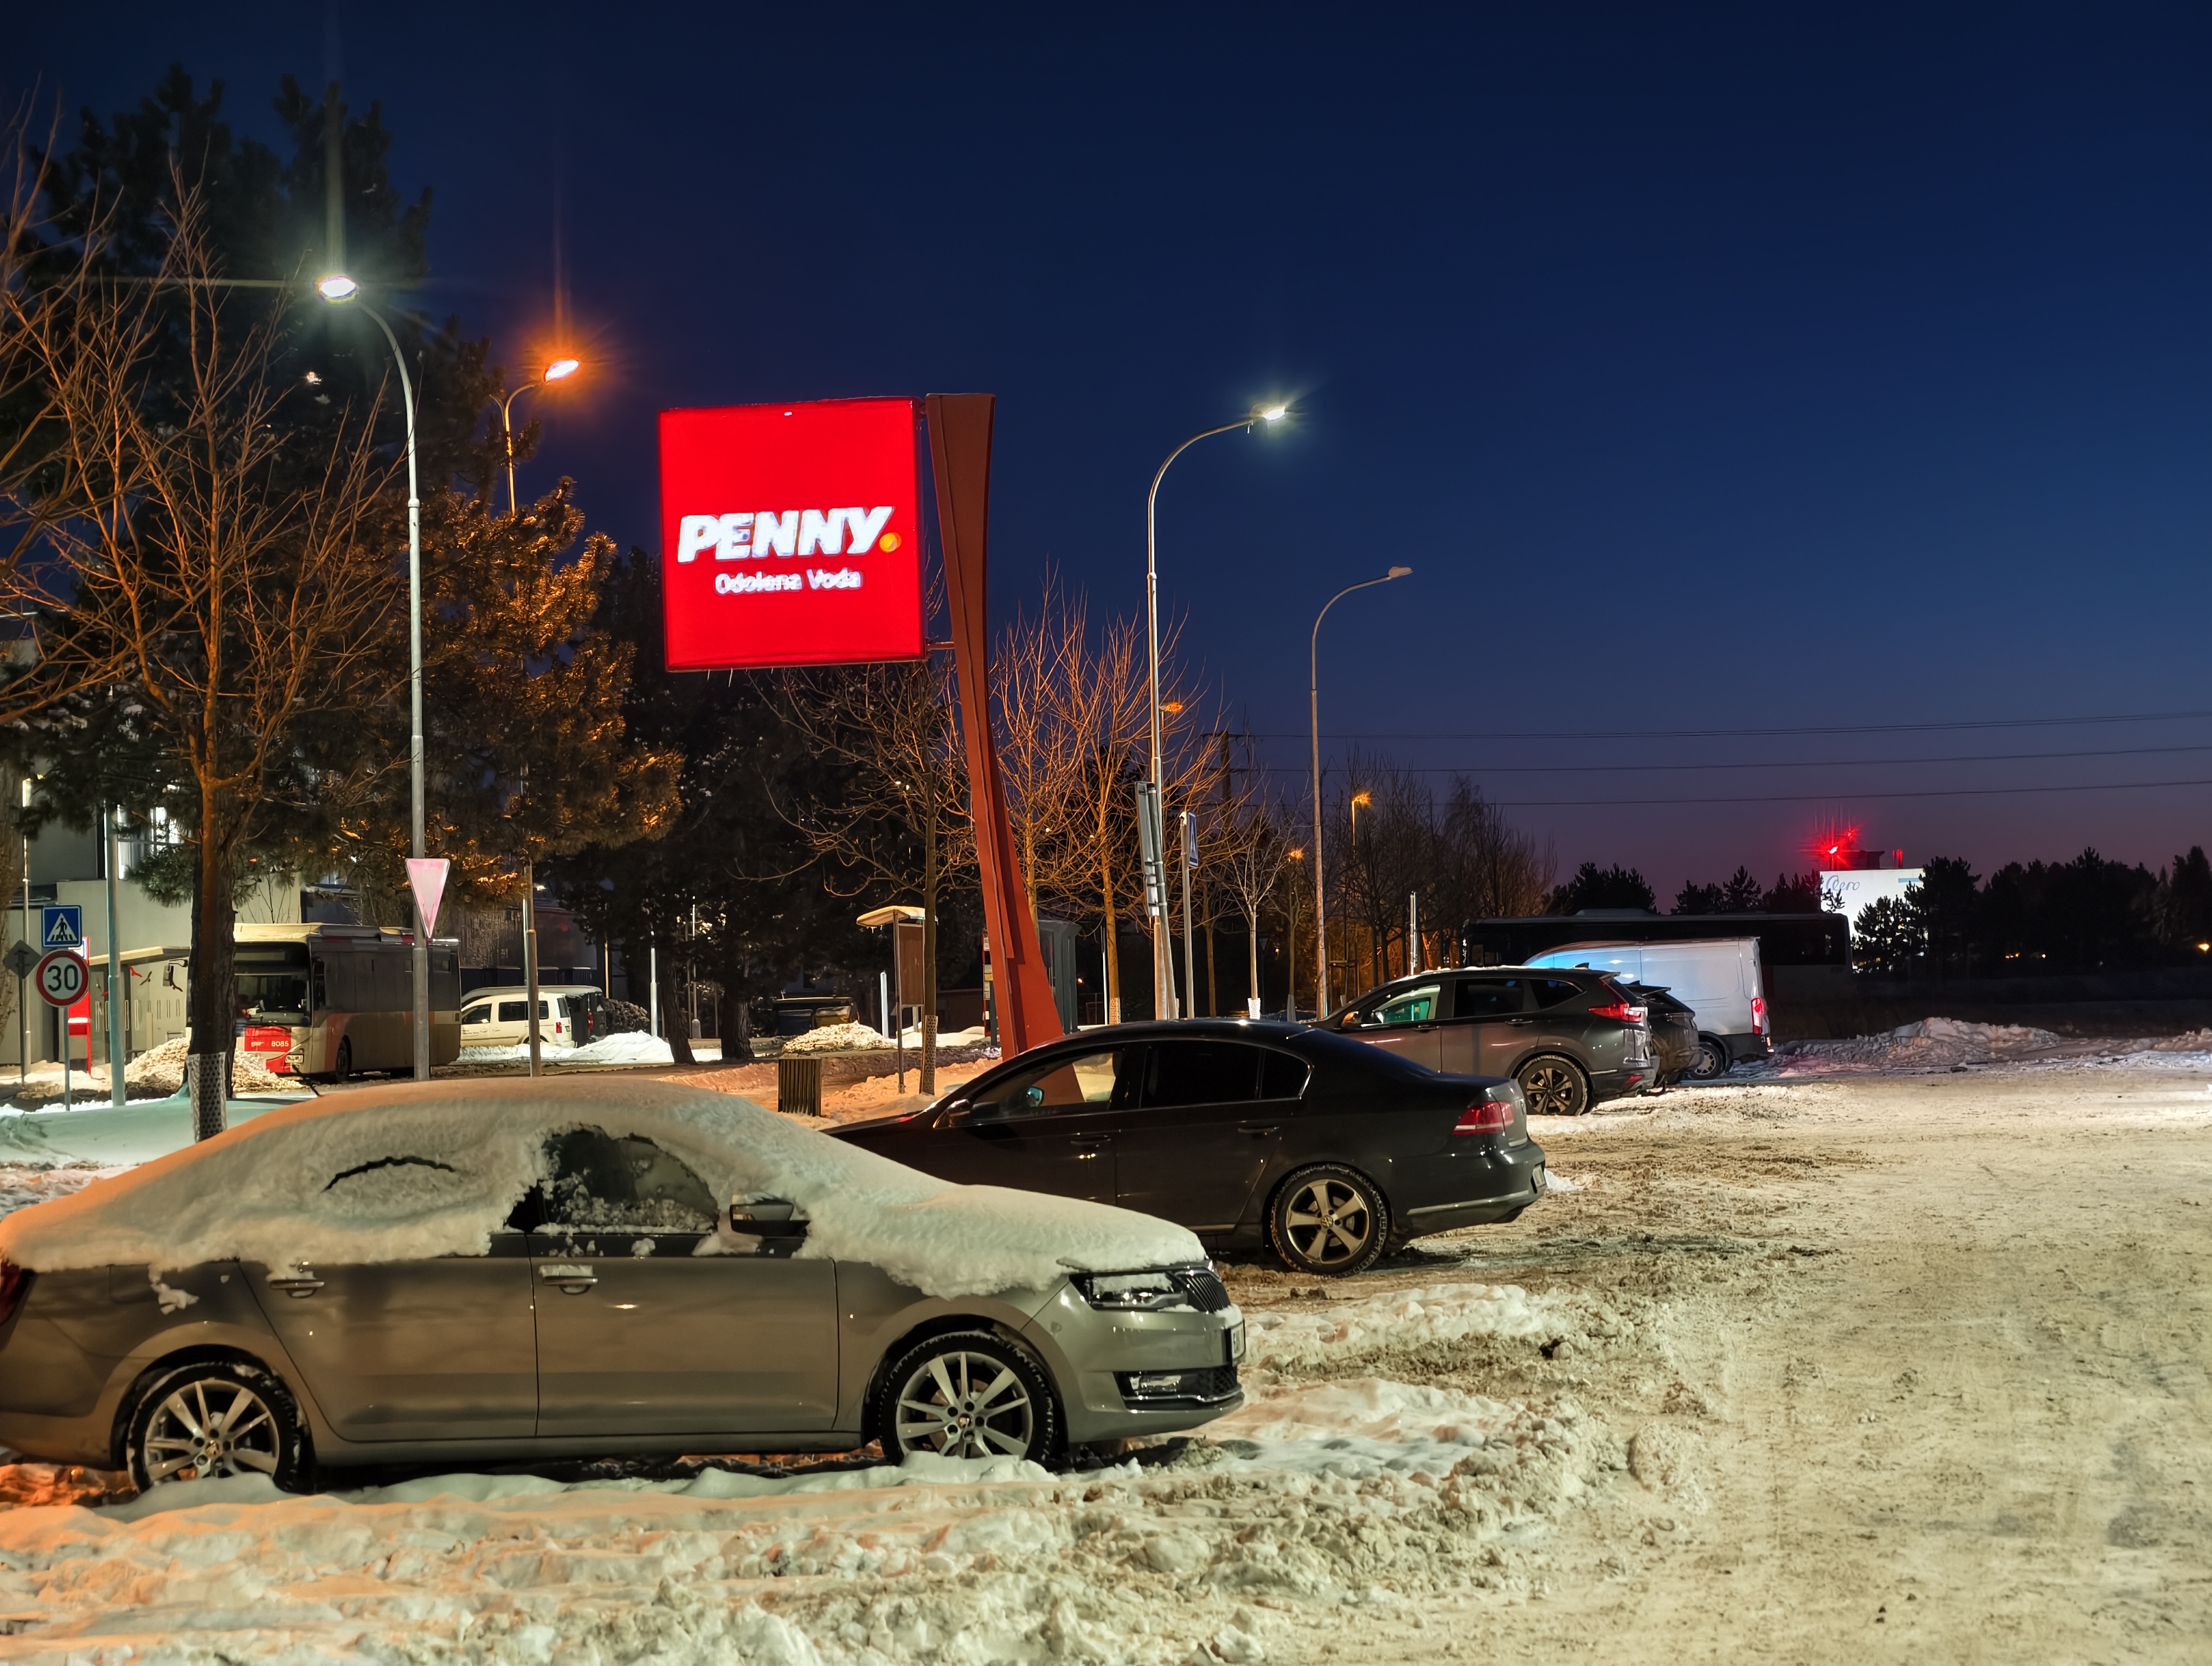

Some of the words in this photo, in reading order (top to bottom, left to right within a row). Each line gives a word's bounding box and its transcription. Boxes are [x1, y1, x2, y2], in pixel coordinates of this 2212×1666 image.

[806, 567, 861, 590] Voda
[1825, 875, 1860, 891] Aero
[47, 964, 78, 992] 30
